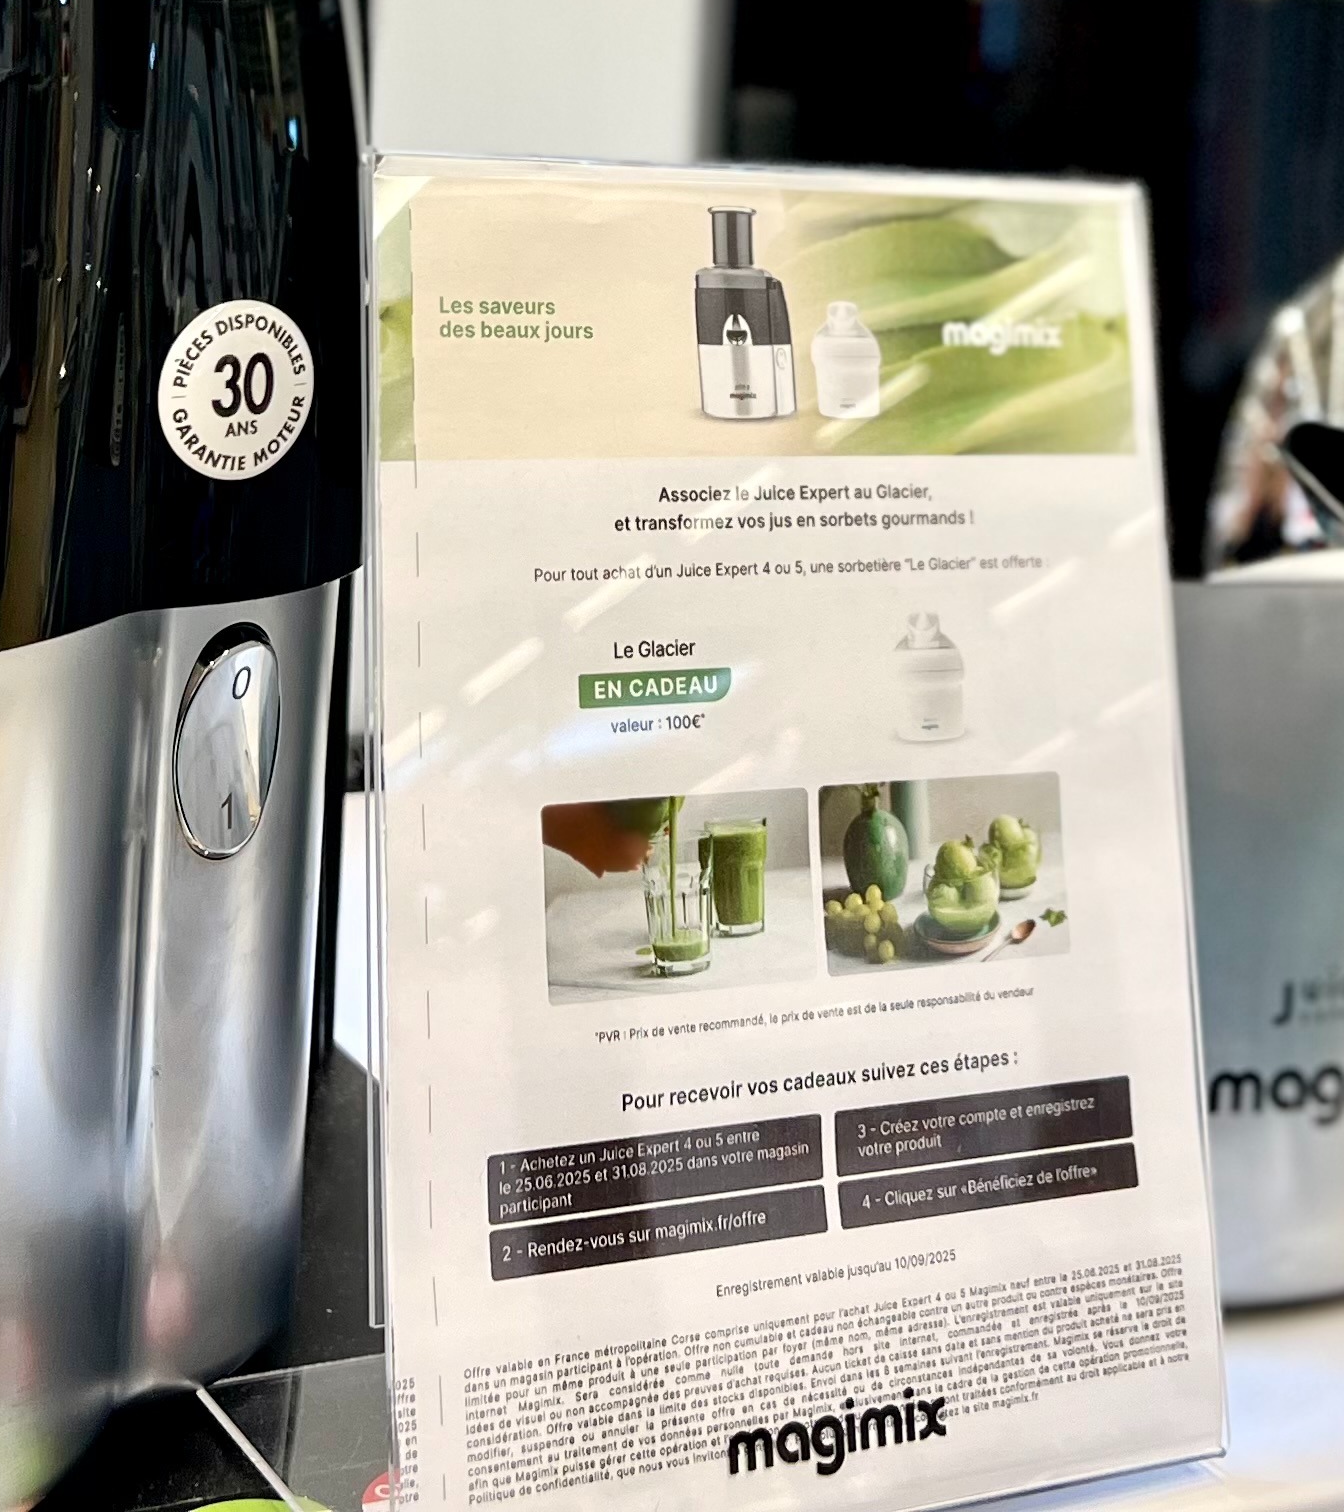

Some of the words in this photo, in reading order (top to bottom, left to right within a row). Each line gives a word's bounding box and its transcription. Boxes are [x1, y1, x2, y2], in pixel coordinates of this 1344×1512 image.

[439, 296, 473, 314] Les
[479, 300, 555, 315] saveurs
[439, 320, 475, 338] des
[480, 320, 540, 338] beaux
[544, 320, 593, 343] jours
[173, 330, 213, 388] PIÈCES
[215, 313, 306, 375] DISPONIBLES
[212, 352, 274, 418] 30
[172, 408, 246, 471] GARANTIE
[254, 395, 306, 467] MOTEUR
[225, 420, 258, 438] ANS
[658, 485, 731, 502] Associez
[735, 485, 749, 501] le
[754, 484, 795, 501] Juice
[799, 485, 850, 503] Expert
[854, 487, 872, 499] au
[614, 516, 631, 531] et
[634, 513, 733, 531] transformez
[737, 516, 765, 528] vos
[769, 511, 792, 531] jus
[796, 515, 815, 527] en
[819, 511, 877, 527] sorbets
[881, 510, 965, 530] gourmands
[534, 568, 566, 582] Pour
[570, 567, 598, 581] tout
[602, 565, 640, 580] achat
[644, 564, 672, 578] d'un
[676, 563, 711, 578] Juice
[715, 562, 758, 578] Expert
[762, 561, 770, 574] 4
[774, 563, 791, 574] ou
[810, 562, 833, 573] une
[837, 558, 901, 573] sorbetière
[979, 557, 998, 569] est
[613, 641, 633, 659] Le
[638, 639, 696, 658] Glacier
[594, 679, 622, 699] EN
[630, 675, 718, 697] CADEAU
[610, 718, 654, 733] valeur
[629, 1028, 648, 1039] Prix
[667, 1023, 696, 1035] vente
[781, 1011, 799, 1025] prix
[817, 1007, 844, 1019] vente
[846, 1004, 862, 1015] est
[890, 999, 914, 1011] seule
[997, 987, 1034, 999] vendeur
[622, 1093, 664, 1111] Pour
[669, 1080, 742, 1105] recevoir
[747, 1079, 778, 1095] vos
[783, 1070, 856, 1091] cadeaux
[861, 1062, 915, 1082] suivez
[920, 1059, 949, 1075] ces
[954, 1052, 1009, 1072] étapes
[880, 1118, 918, 1135] Créez
[921, 1115, 955, 1130] votre
[958, 1108, 1007, 1126] compte
[1009, 1105, 1023, 1119] et
[1025, 1097, 1094, 1117] enregistrez
[520, 1154, 575, 1172] Achetez
[579, 1151, 595, 1164] un
[599, 1146, 634, 1161] Juice
[637, 1139, 679, 1157] Expert
[683, 1136, 692, 1150] 4
[695, 1137, 711, 1149] ou
[715, 1132, 723, 1146] 5
[726, 1130, 760, 1145] entre
[857, 1141, 892, 1157] votre
[895, 1134, 942, 1156] produit
[499, 1181, 511, 1195] le
[515, 1169, 591, 1193] 25.06.2025
[594, 1168, 607, 1182] et
[612, 1157, 683, 1179] 31.08.2025
[686, 1150, 719, 1170] dans
[721, 1148, 753, 1165] votre
[756, 1139, 809, 1163] magasin
[884, 1188, 933, 1206] Cliquez
[936, 1184, 957, 1199] sur
[1036, 1170, 1053, 1184] de
[499, 1192, 572, 1219] participant
[527, 1232, 624, 1257] Rendez-vous
[628, 1228, 651, 1243] sur
[655, 1210, 766, 1239] magimix.fr/offre
[716, 1273, 802, 1297] Enregistrement
[805, 1267, 844, 1283] valable
[847, 1260, 891, 1280] jusqu'au
[894, 1248, 956, 1269] 10/09/2025
[463, 1366, 490, 1379] Offre
[495, 1359, 532, 1374] valable
[537, 1357, 550, 1367] en
[554, 1351, 590, 1364] France
[729, 1387, 947, 1477] magimix
